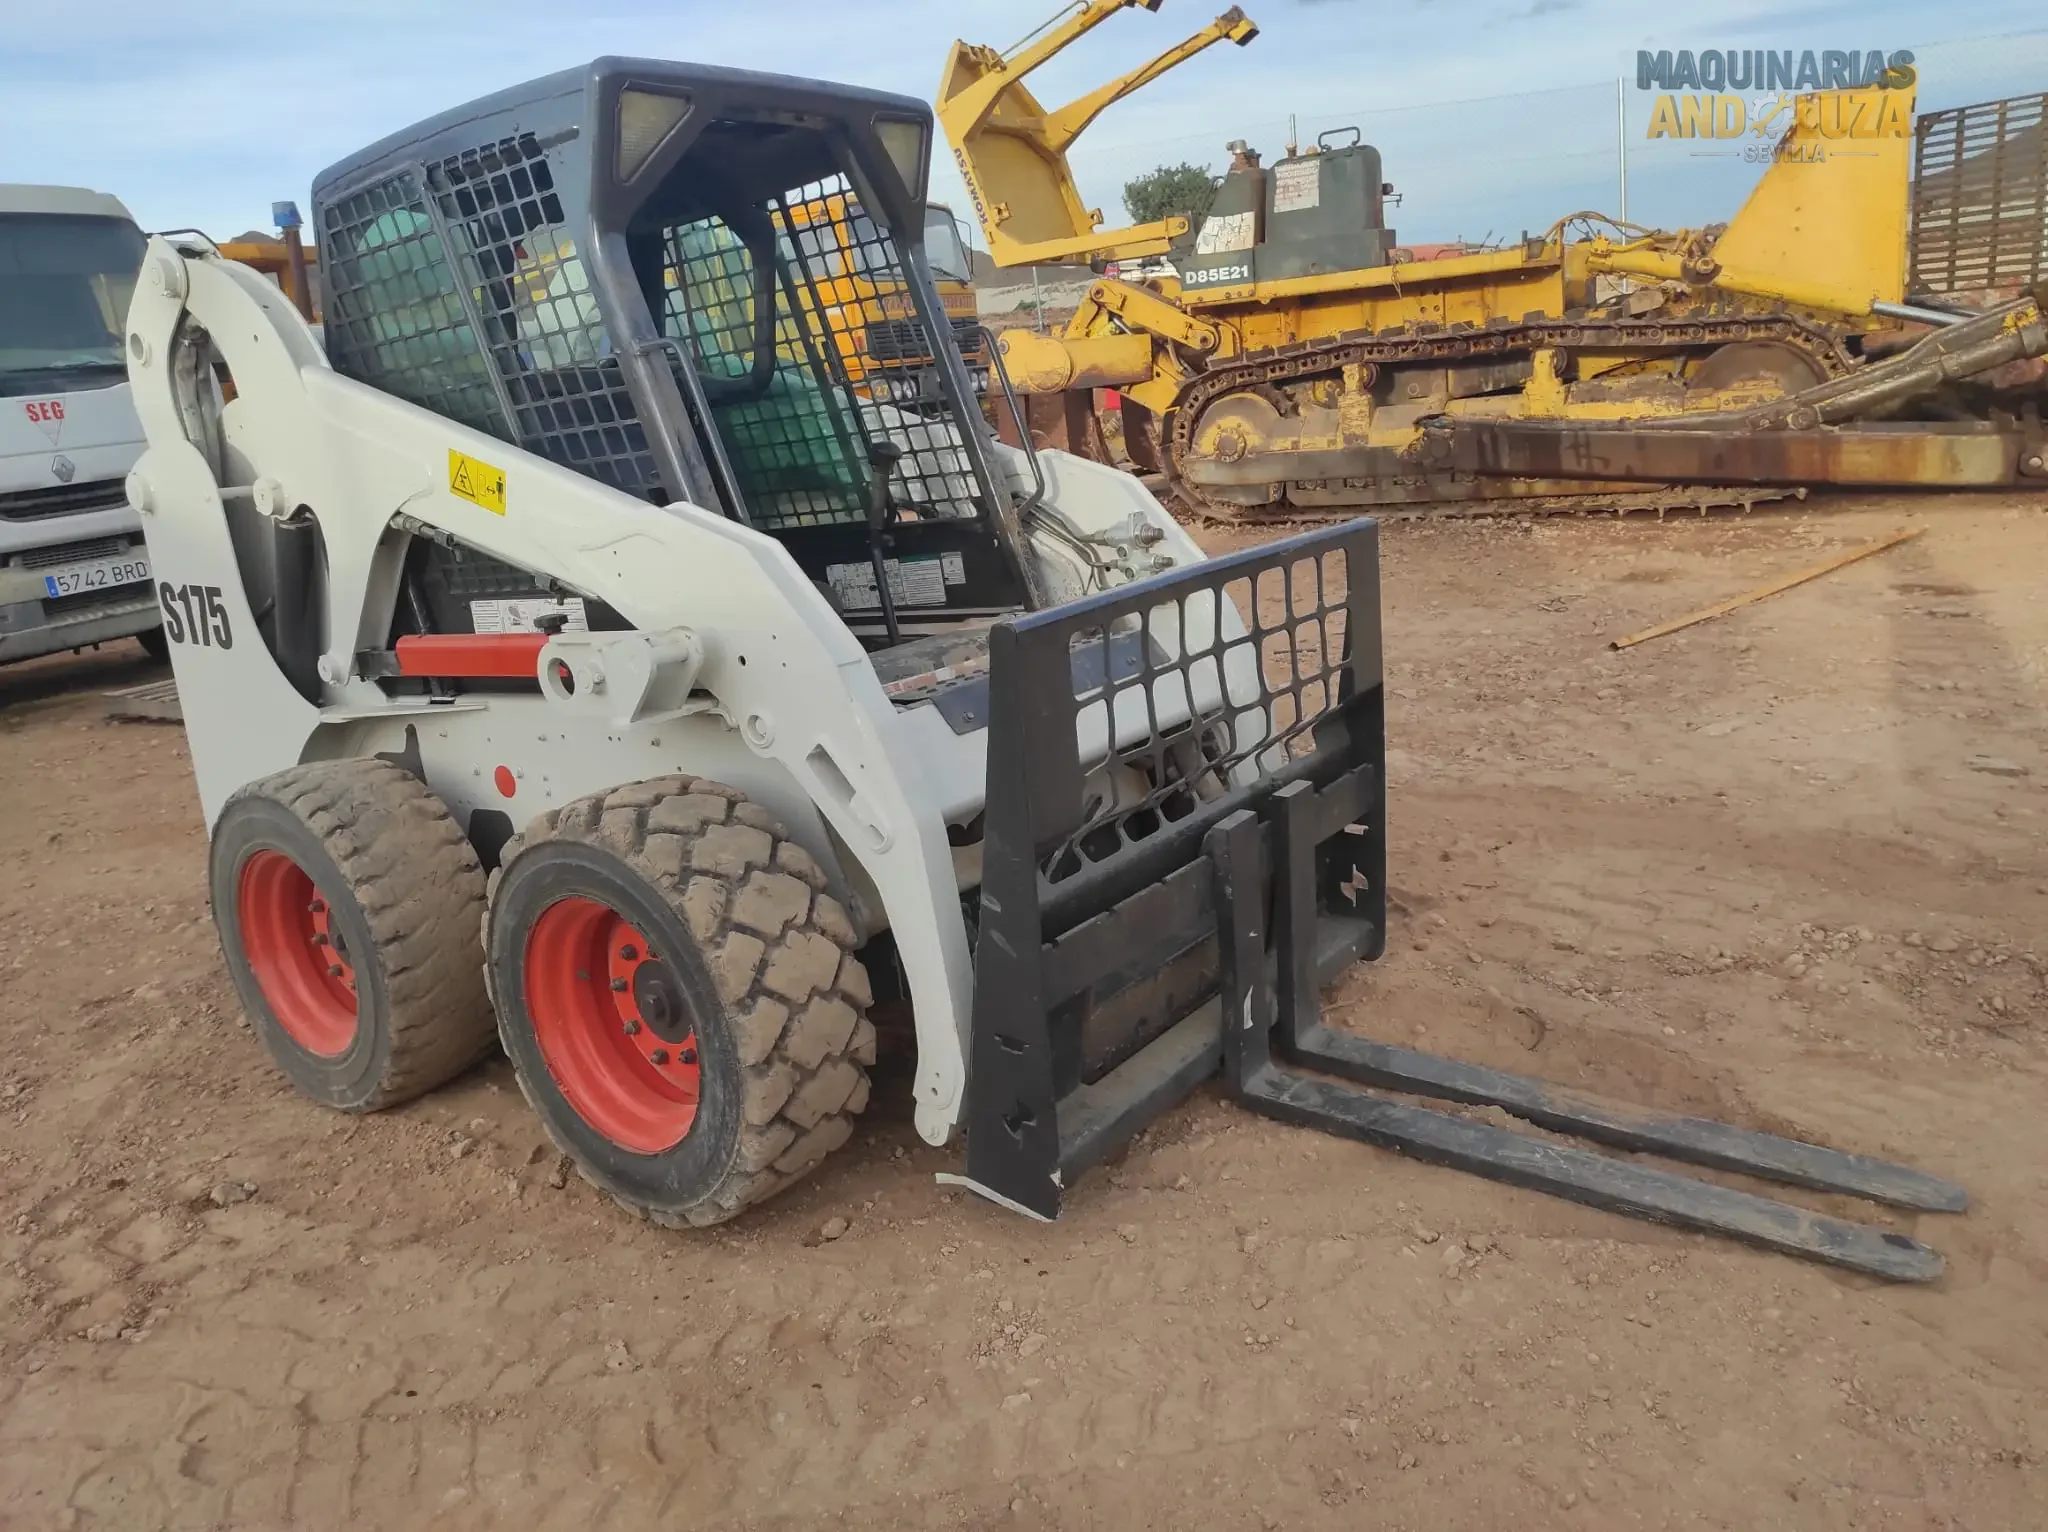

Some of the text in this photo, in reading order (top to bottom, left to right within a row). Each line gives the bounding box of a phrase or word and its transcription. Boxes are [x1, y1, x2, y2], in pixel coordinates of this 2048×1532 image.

[954, 147, 989, 225] KOMATSU
[1185, 264, 1249, 285] D85E21
[25, 401, 65, 423] SEG
[56, 561, 148, 592] 5742 BRD
[159, 581, 233, 650] S175
